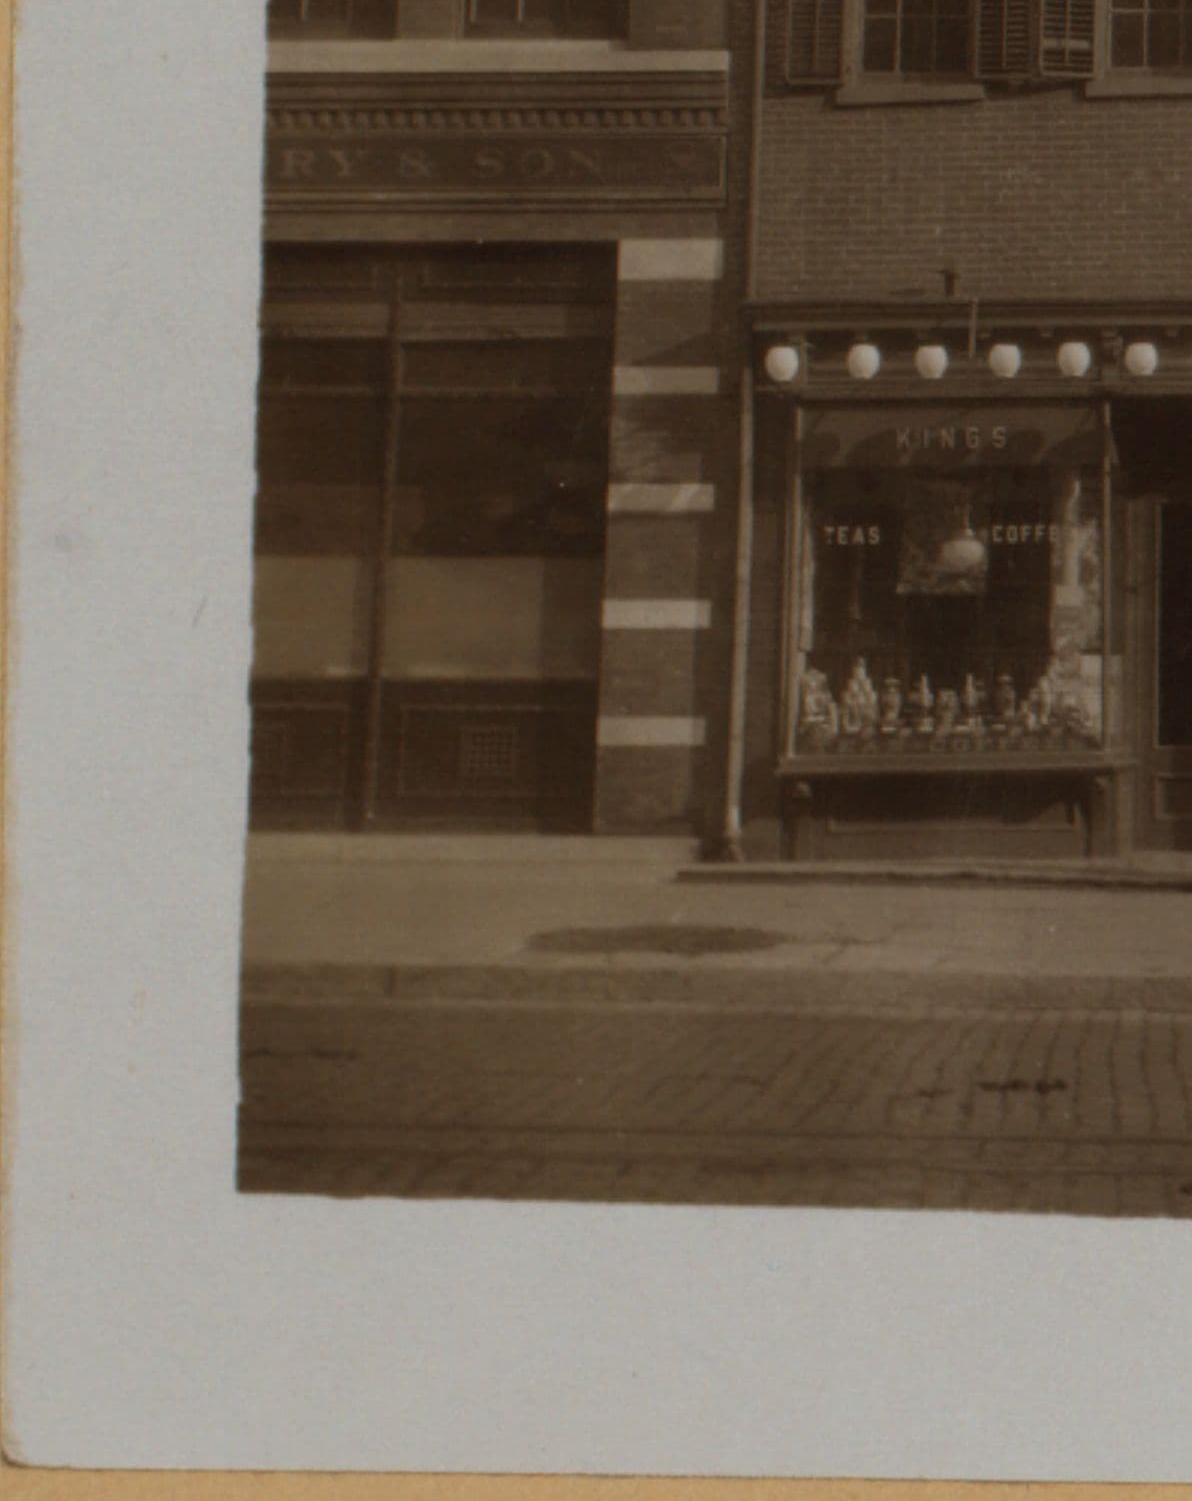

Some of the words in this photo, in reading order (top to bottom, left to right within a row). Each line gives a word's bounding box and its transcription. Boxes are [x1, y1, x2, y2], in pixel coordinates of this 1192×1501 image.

[399, 149, 434, 180] &
[897, 426, 1007, 449] KINGS
[824, 525, 881, 545] TEAS
[992, 524, 1072, 545] COFFE
